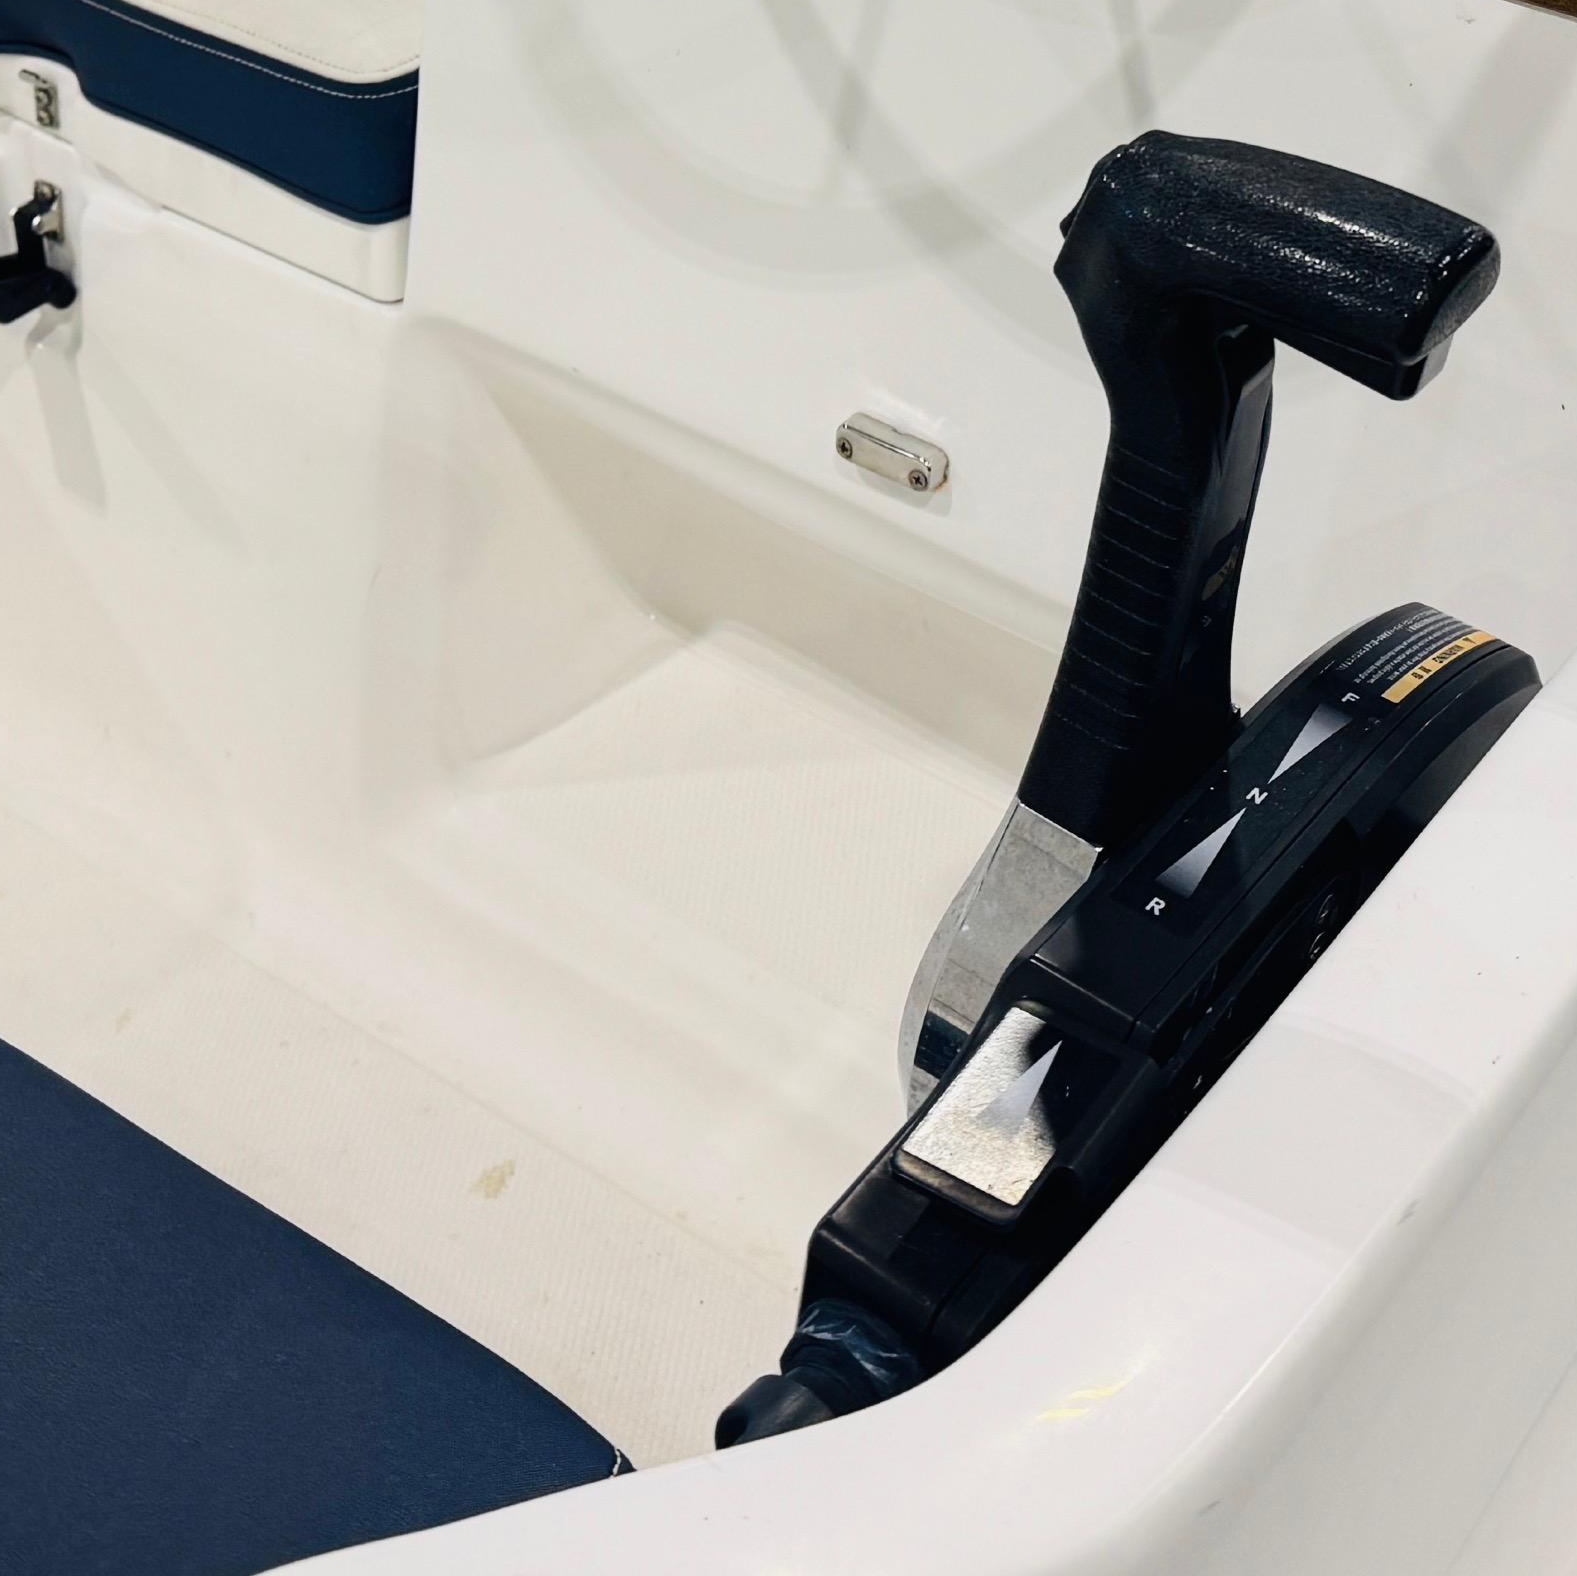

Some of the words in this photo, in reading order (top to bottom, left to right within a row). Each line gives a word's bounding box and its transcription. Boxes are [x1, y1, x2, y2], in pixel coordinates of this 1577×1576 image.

[1341, 692, 1361, 703] F
[1246, 787, 1268, 805] N
[1144, 897, 1166, 916] R
